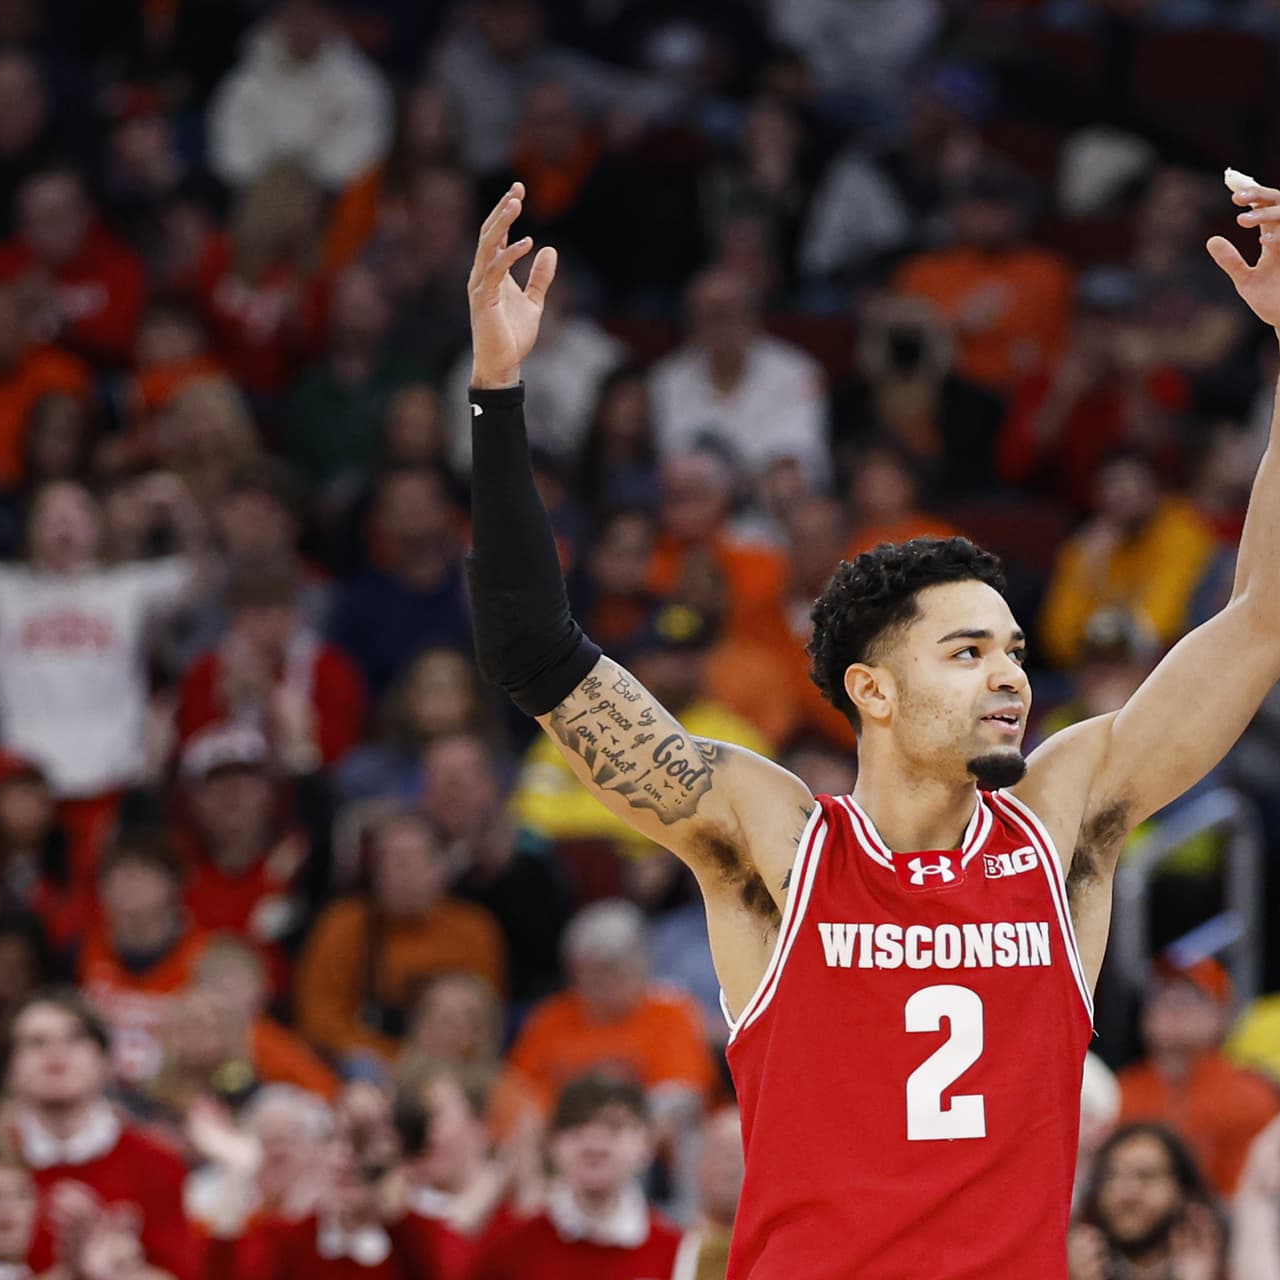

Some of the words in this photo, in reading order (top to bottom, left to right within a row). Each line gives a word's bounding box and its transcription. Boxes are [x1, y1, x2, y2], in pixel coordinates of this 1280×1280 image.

[565, 710, 588, 725] I
[612, 671, 642, 702] But
[638, 706, 657, 727] by
[576, 726, 598, 746] am
[589, 700, 632, 731] grace
[630, 733, 655, 749] of
[652, 733, 707, 792] God
[601, 746, 637, 775] what
[634, 769, 651, 784] I
[818, 921, 1051, 969] WISCONSIN
[905, 984, 987, 1141] 2
